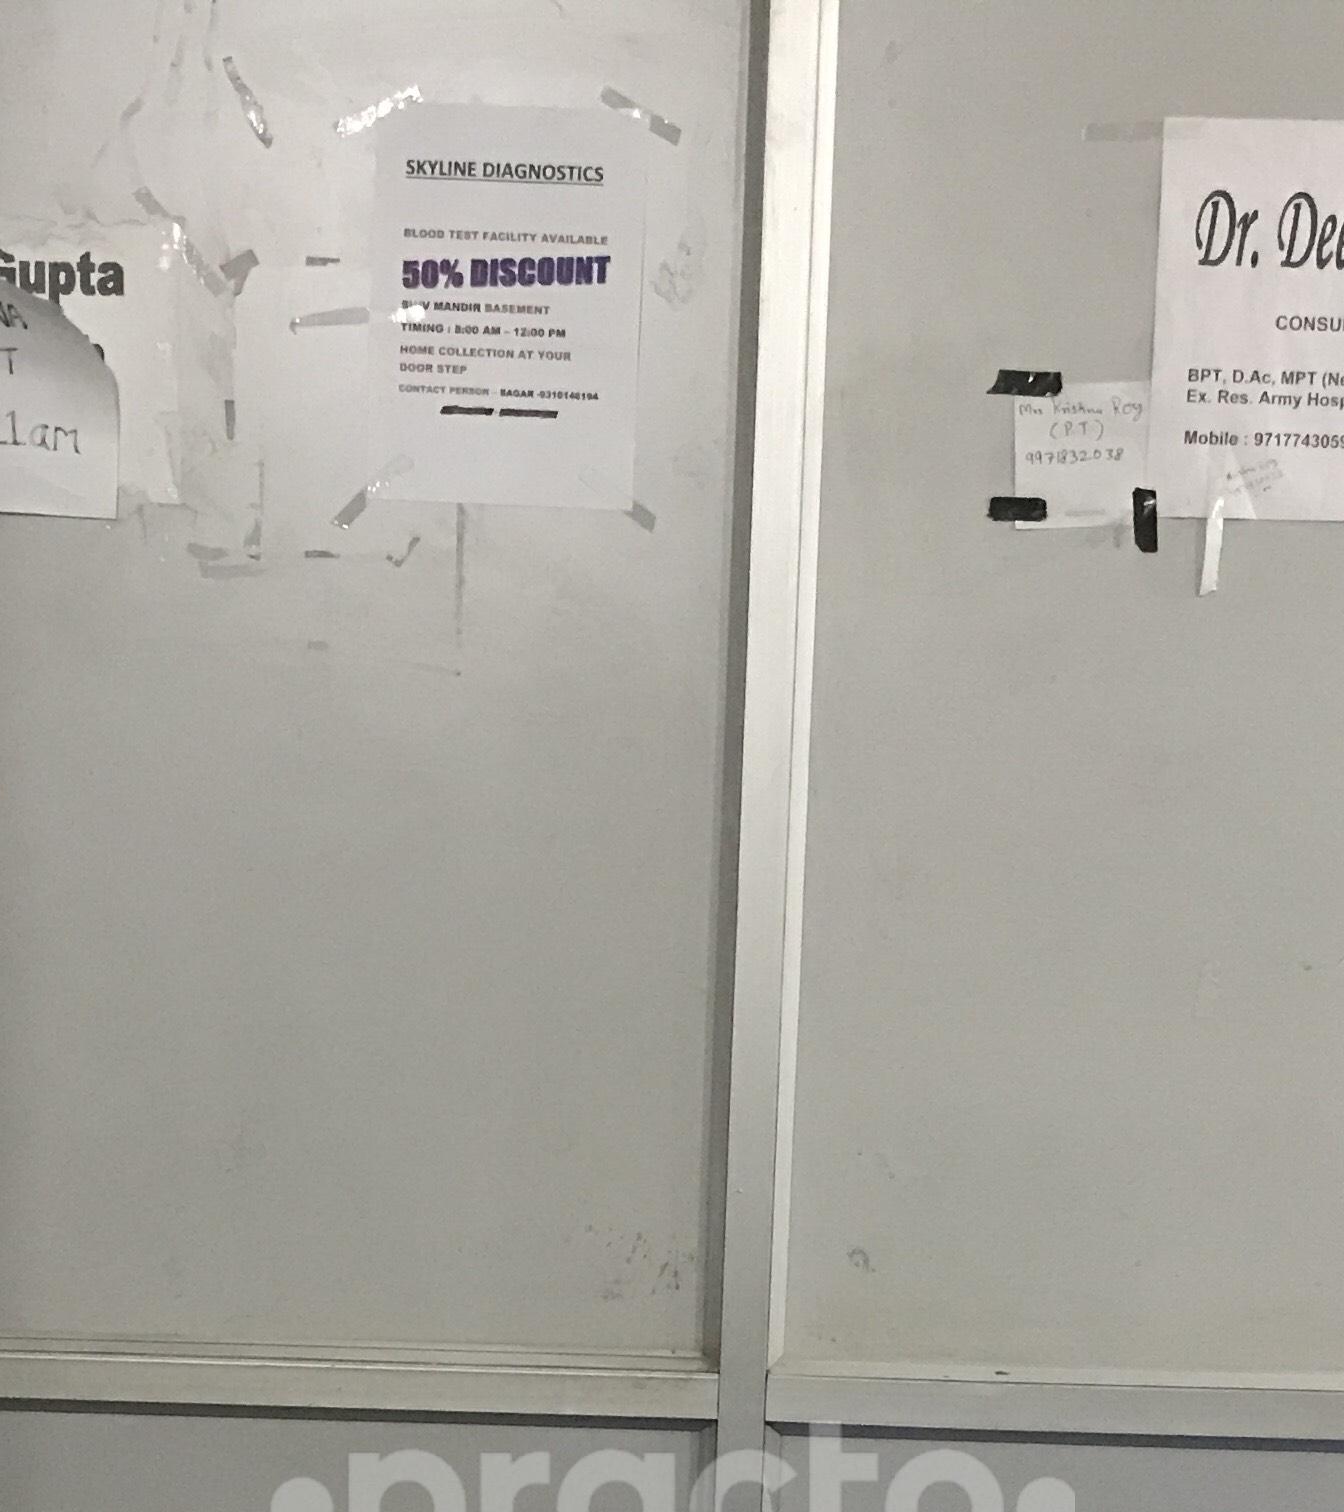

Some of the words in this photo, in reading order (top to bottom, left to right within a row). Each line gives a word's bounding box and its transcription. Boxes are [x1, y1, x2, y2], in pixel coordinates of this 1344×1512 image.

[406, 159, 477, 178] SKYLINE
[482, 162, 604, 182] DIAGNOSTICS
[403, 228, 445, 239] BLOOD
[449, 230, 479, 240] TEST
[482, 232, 537, 243] FACILITY
[541, 233, 608, 245] AVAILABLE
[1195, 189, 1260, 268] Dr.
[402, 258, 464, 289] 50%
[470, 255, 611, 287] DISCOUNT
[434, 302, 481, 312] MANDIR
[484, 304, 550, 315] BASEMENT
[401, 322, 443, 333] TIMING
[482, 325, 501, 336] AM
[548, 329, 566, 338] PM
[400, 345, 434, 355] HOME
[438, 346, 514, 358] COLLECTION
[518, 350, 532, 360] AT
[538, 351, 571, 361] YOUR
[399, 363, 433, 373] DOOR
[437, 365, 467, 374] STEP
[1187, 368, 1228, 385] BPT,
[1280, 372, 1317, 386] MPT
[398, 384, 445, 394] CONTACT
[449, 386, 489, 395] PERSON
[1186, 389, 1212, 404] Ex.
[1217, 389, 1250, 405] Res.
[1258, 391, 1301, 411] Army
[1183, 431, 1239, 447] Mobile
